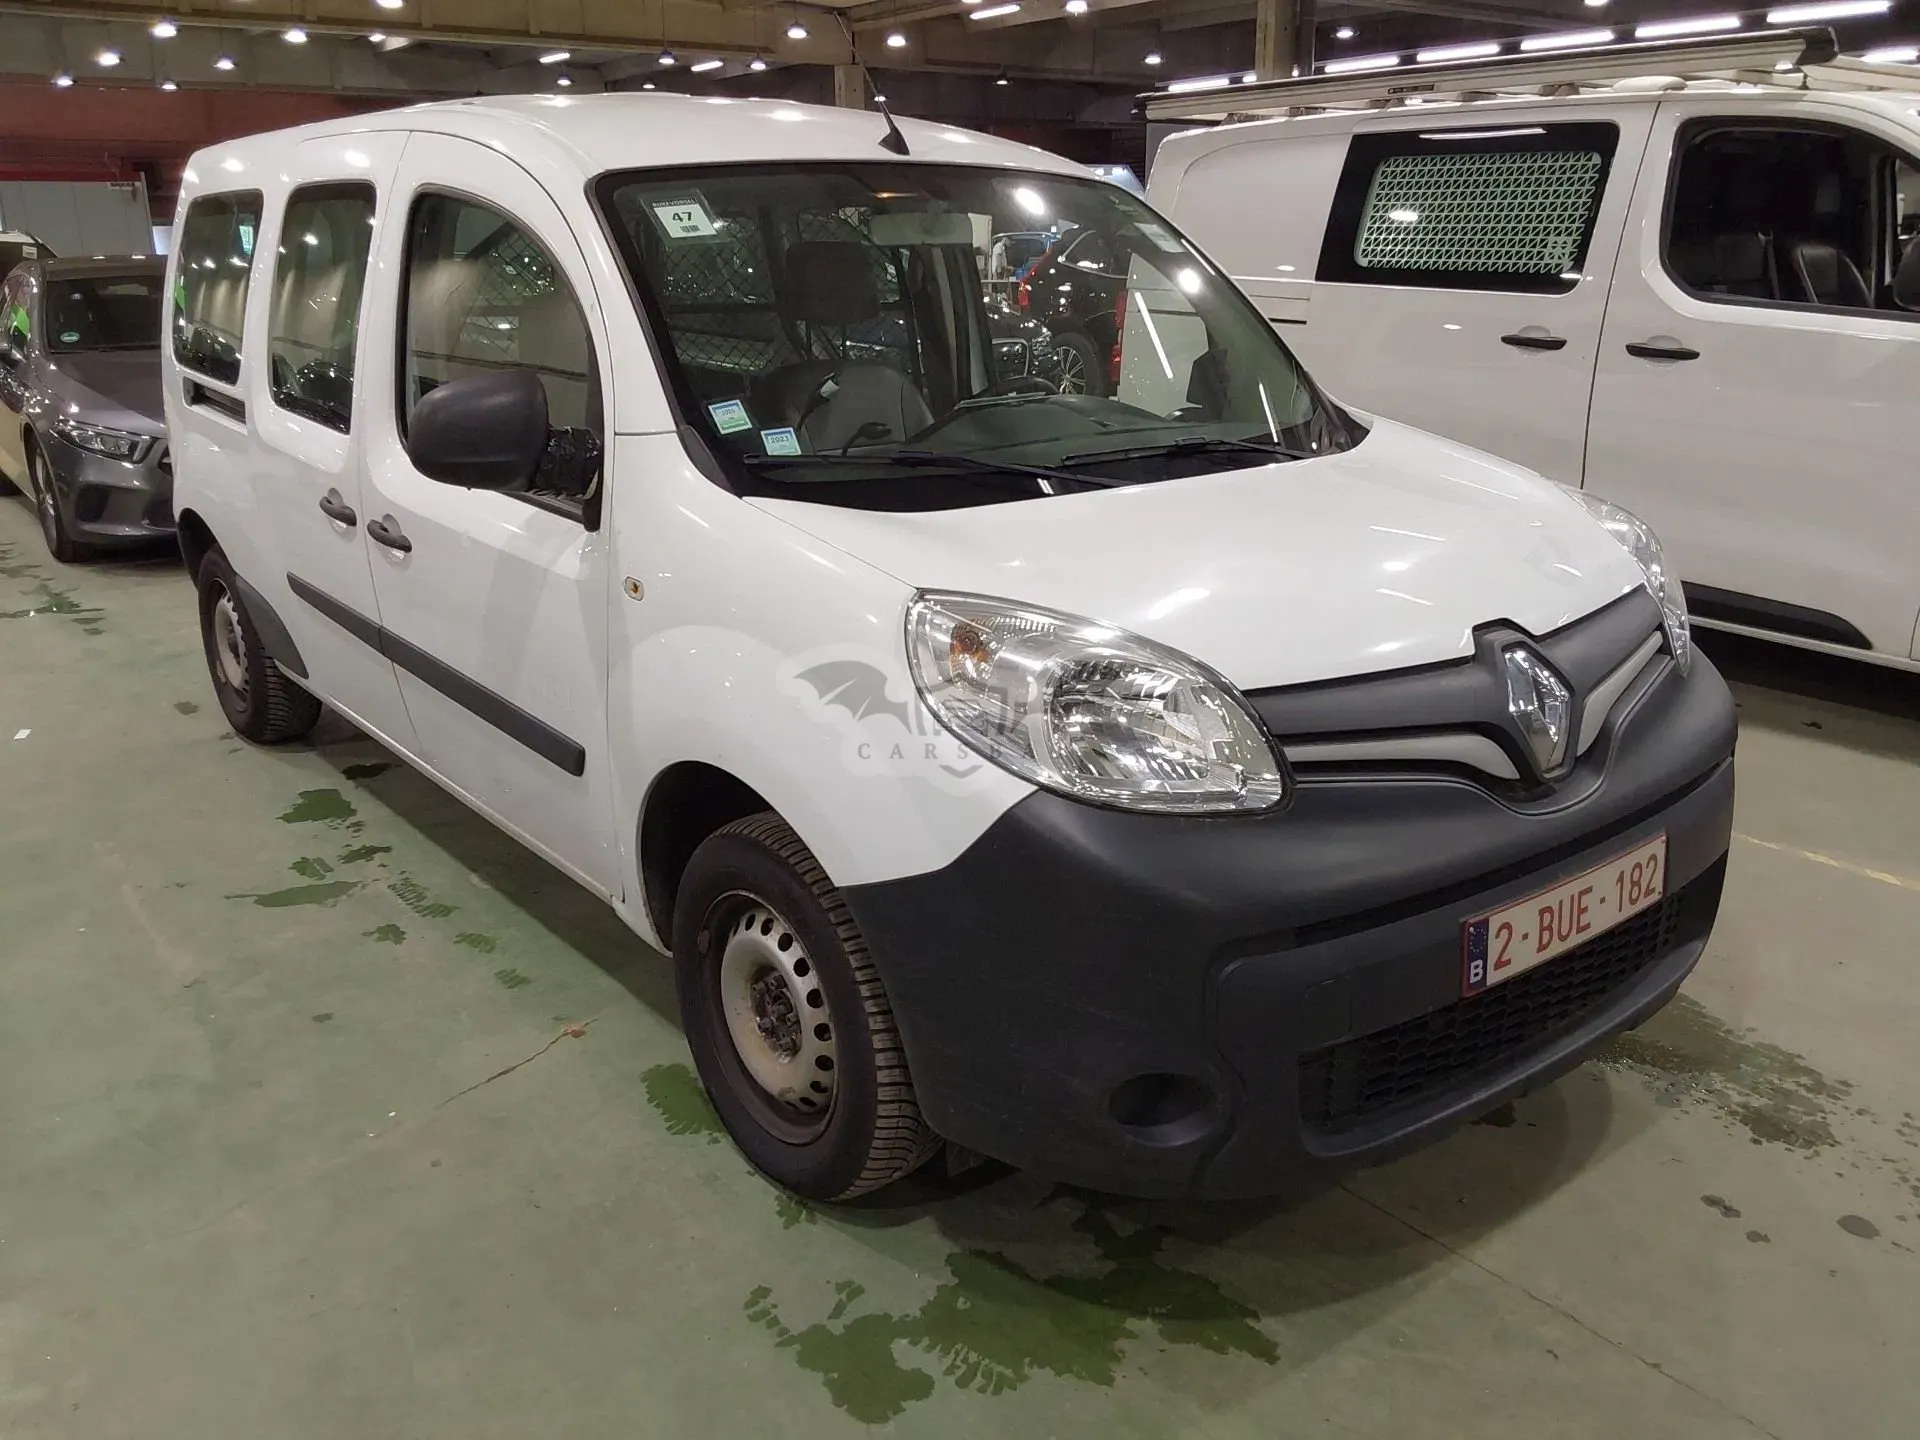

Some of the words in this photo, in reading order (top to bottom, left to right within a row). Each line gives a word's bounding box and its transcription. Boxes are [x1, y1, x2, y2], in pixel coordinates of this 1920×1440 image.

[672, 211, 692, 222] 47
[1493, 853, 1659, 971] 2-BUE-182
[1469, 959, 1484, 984] B
